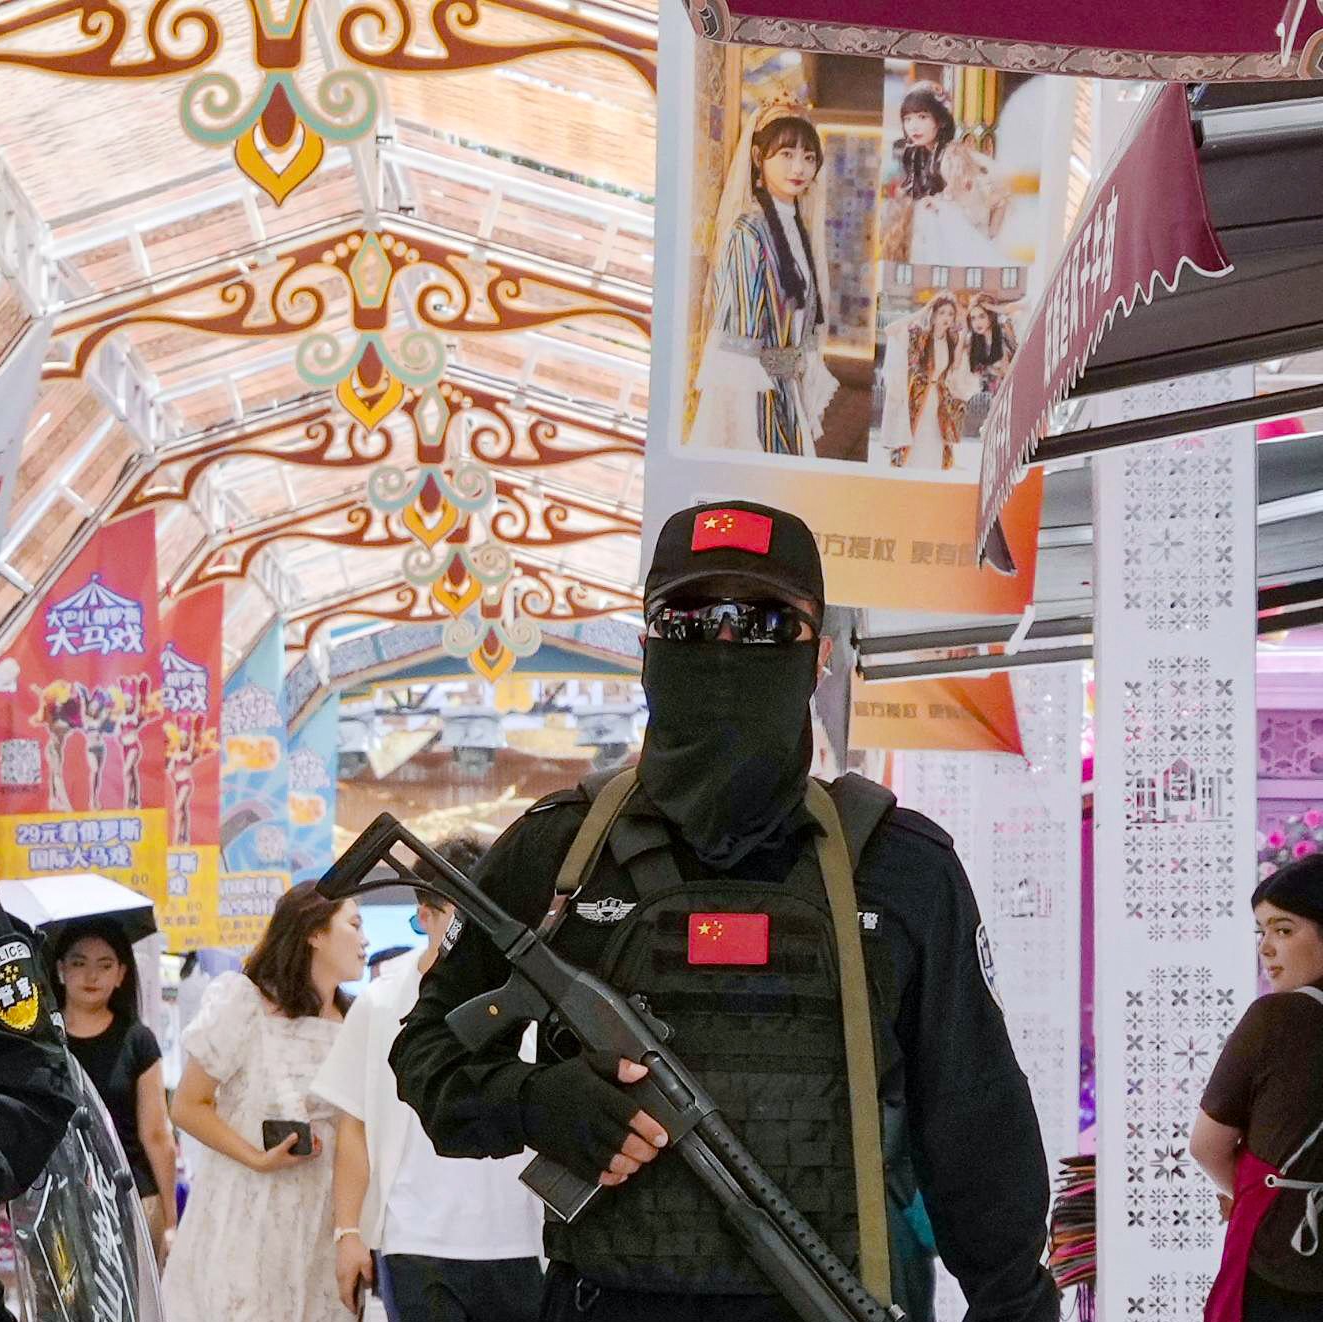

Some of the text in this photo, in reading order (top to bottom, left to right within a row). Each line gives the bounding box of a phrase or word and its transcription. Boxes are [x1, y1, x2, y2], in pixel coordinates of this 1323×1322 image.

[814, 533, 977, 567] 方授权 更有保
[43, 624, 144, 657] 大马戏
